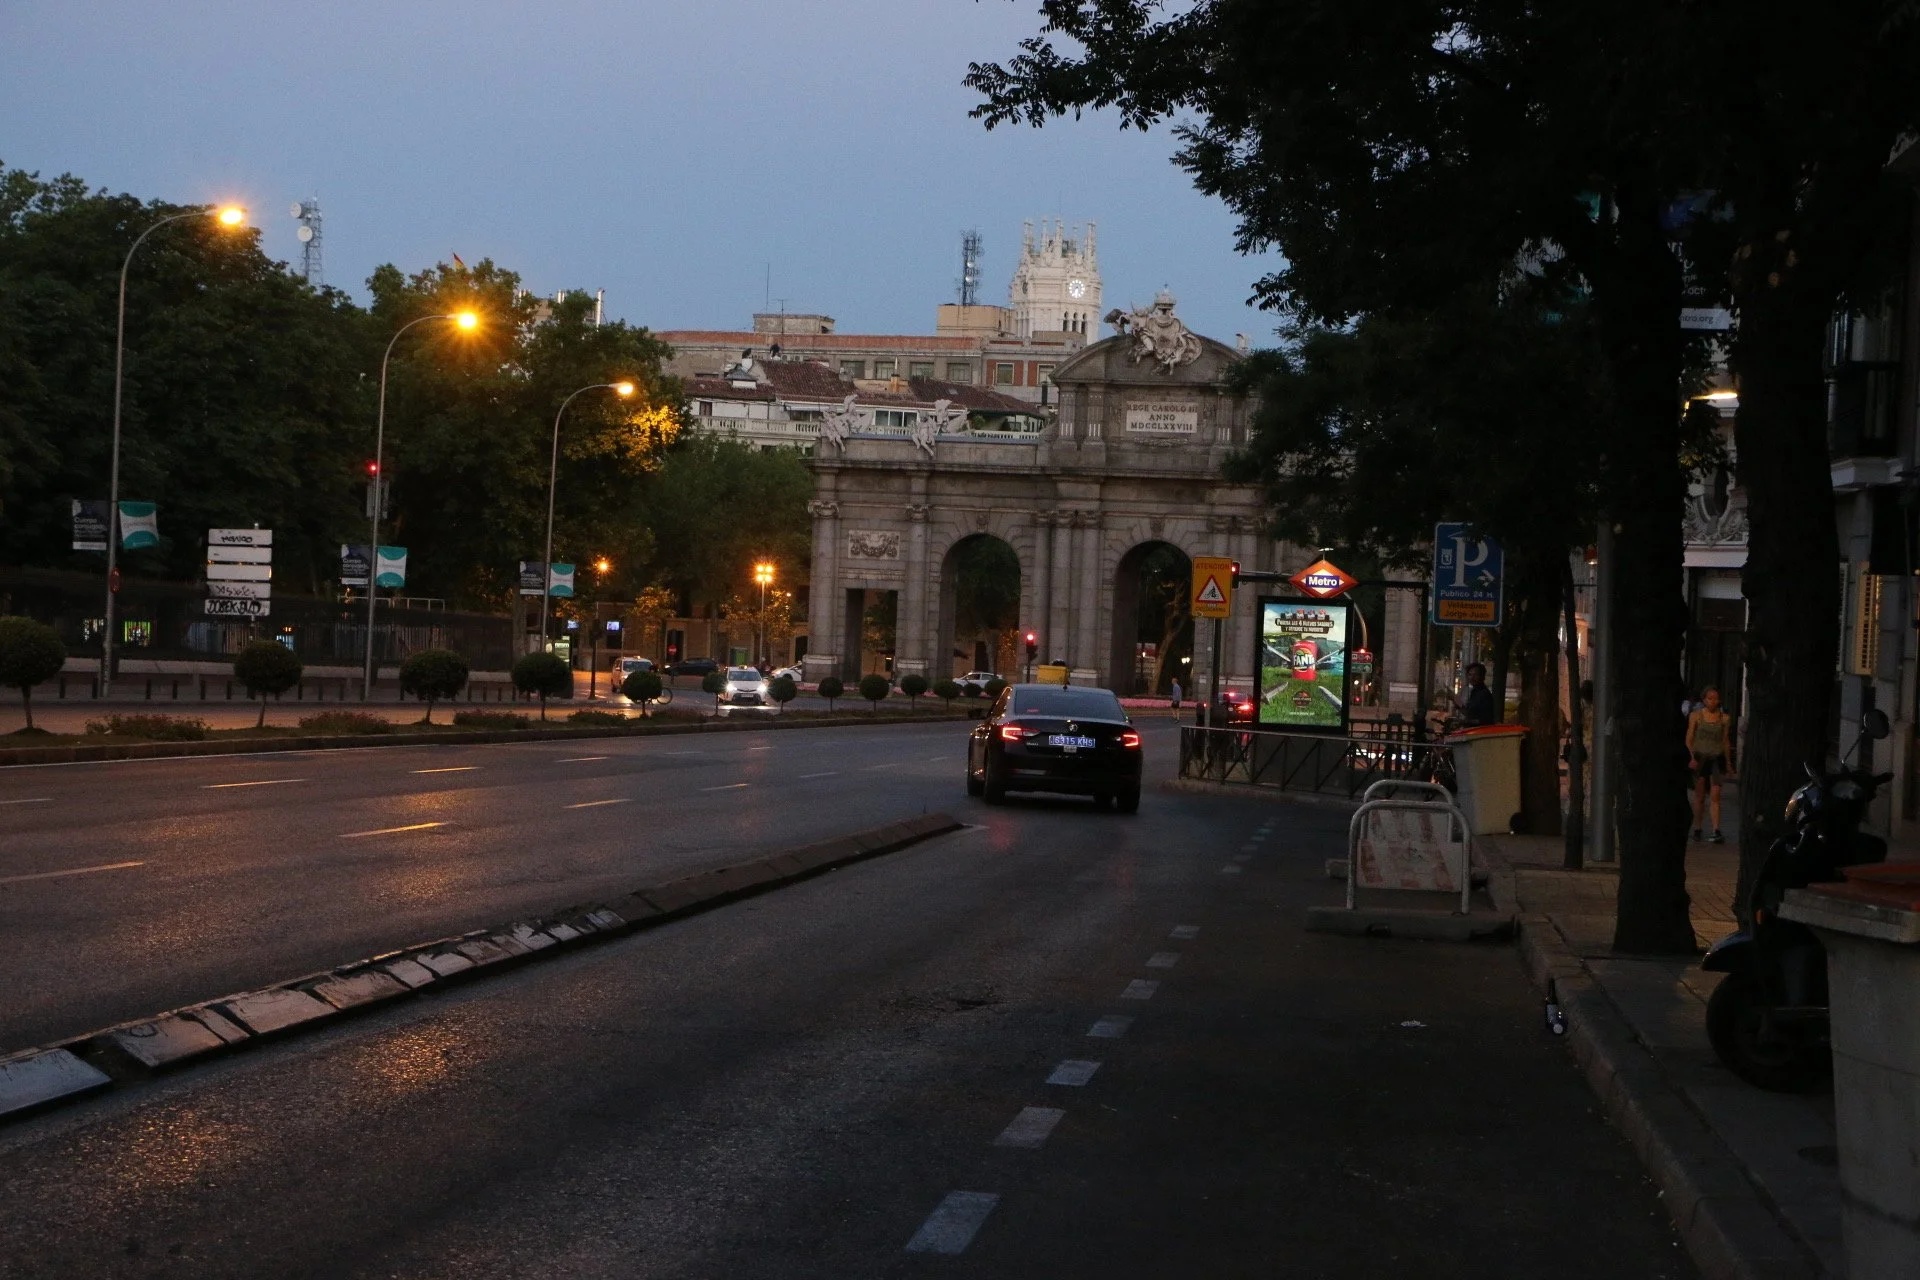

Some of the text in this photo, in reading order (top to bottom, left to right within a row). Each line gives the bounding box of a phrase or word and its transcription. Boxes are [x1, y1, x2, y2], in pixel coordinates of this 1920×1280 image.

[1131, 422, 1192, 430] MDCCLXXVIII
[1308, 576, 1338, 586] Metro
[1077, 738, 1093, 747] KHS
